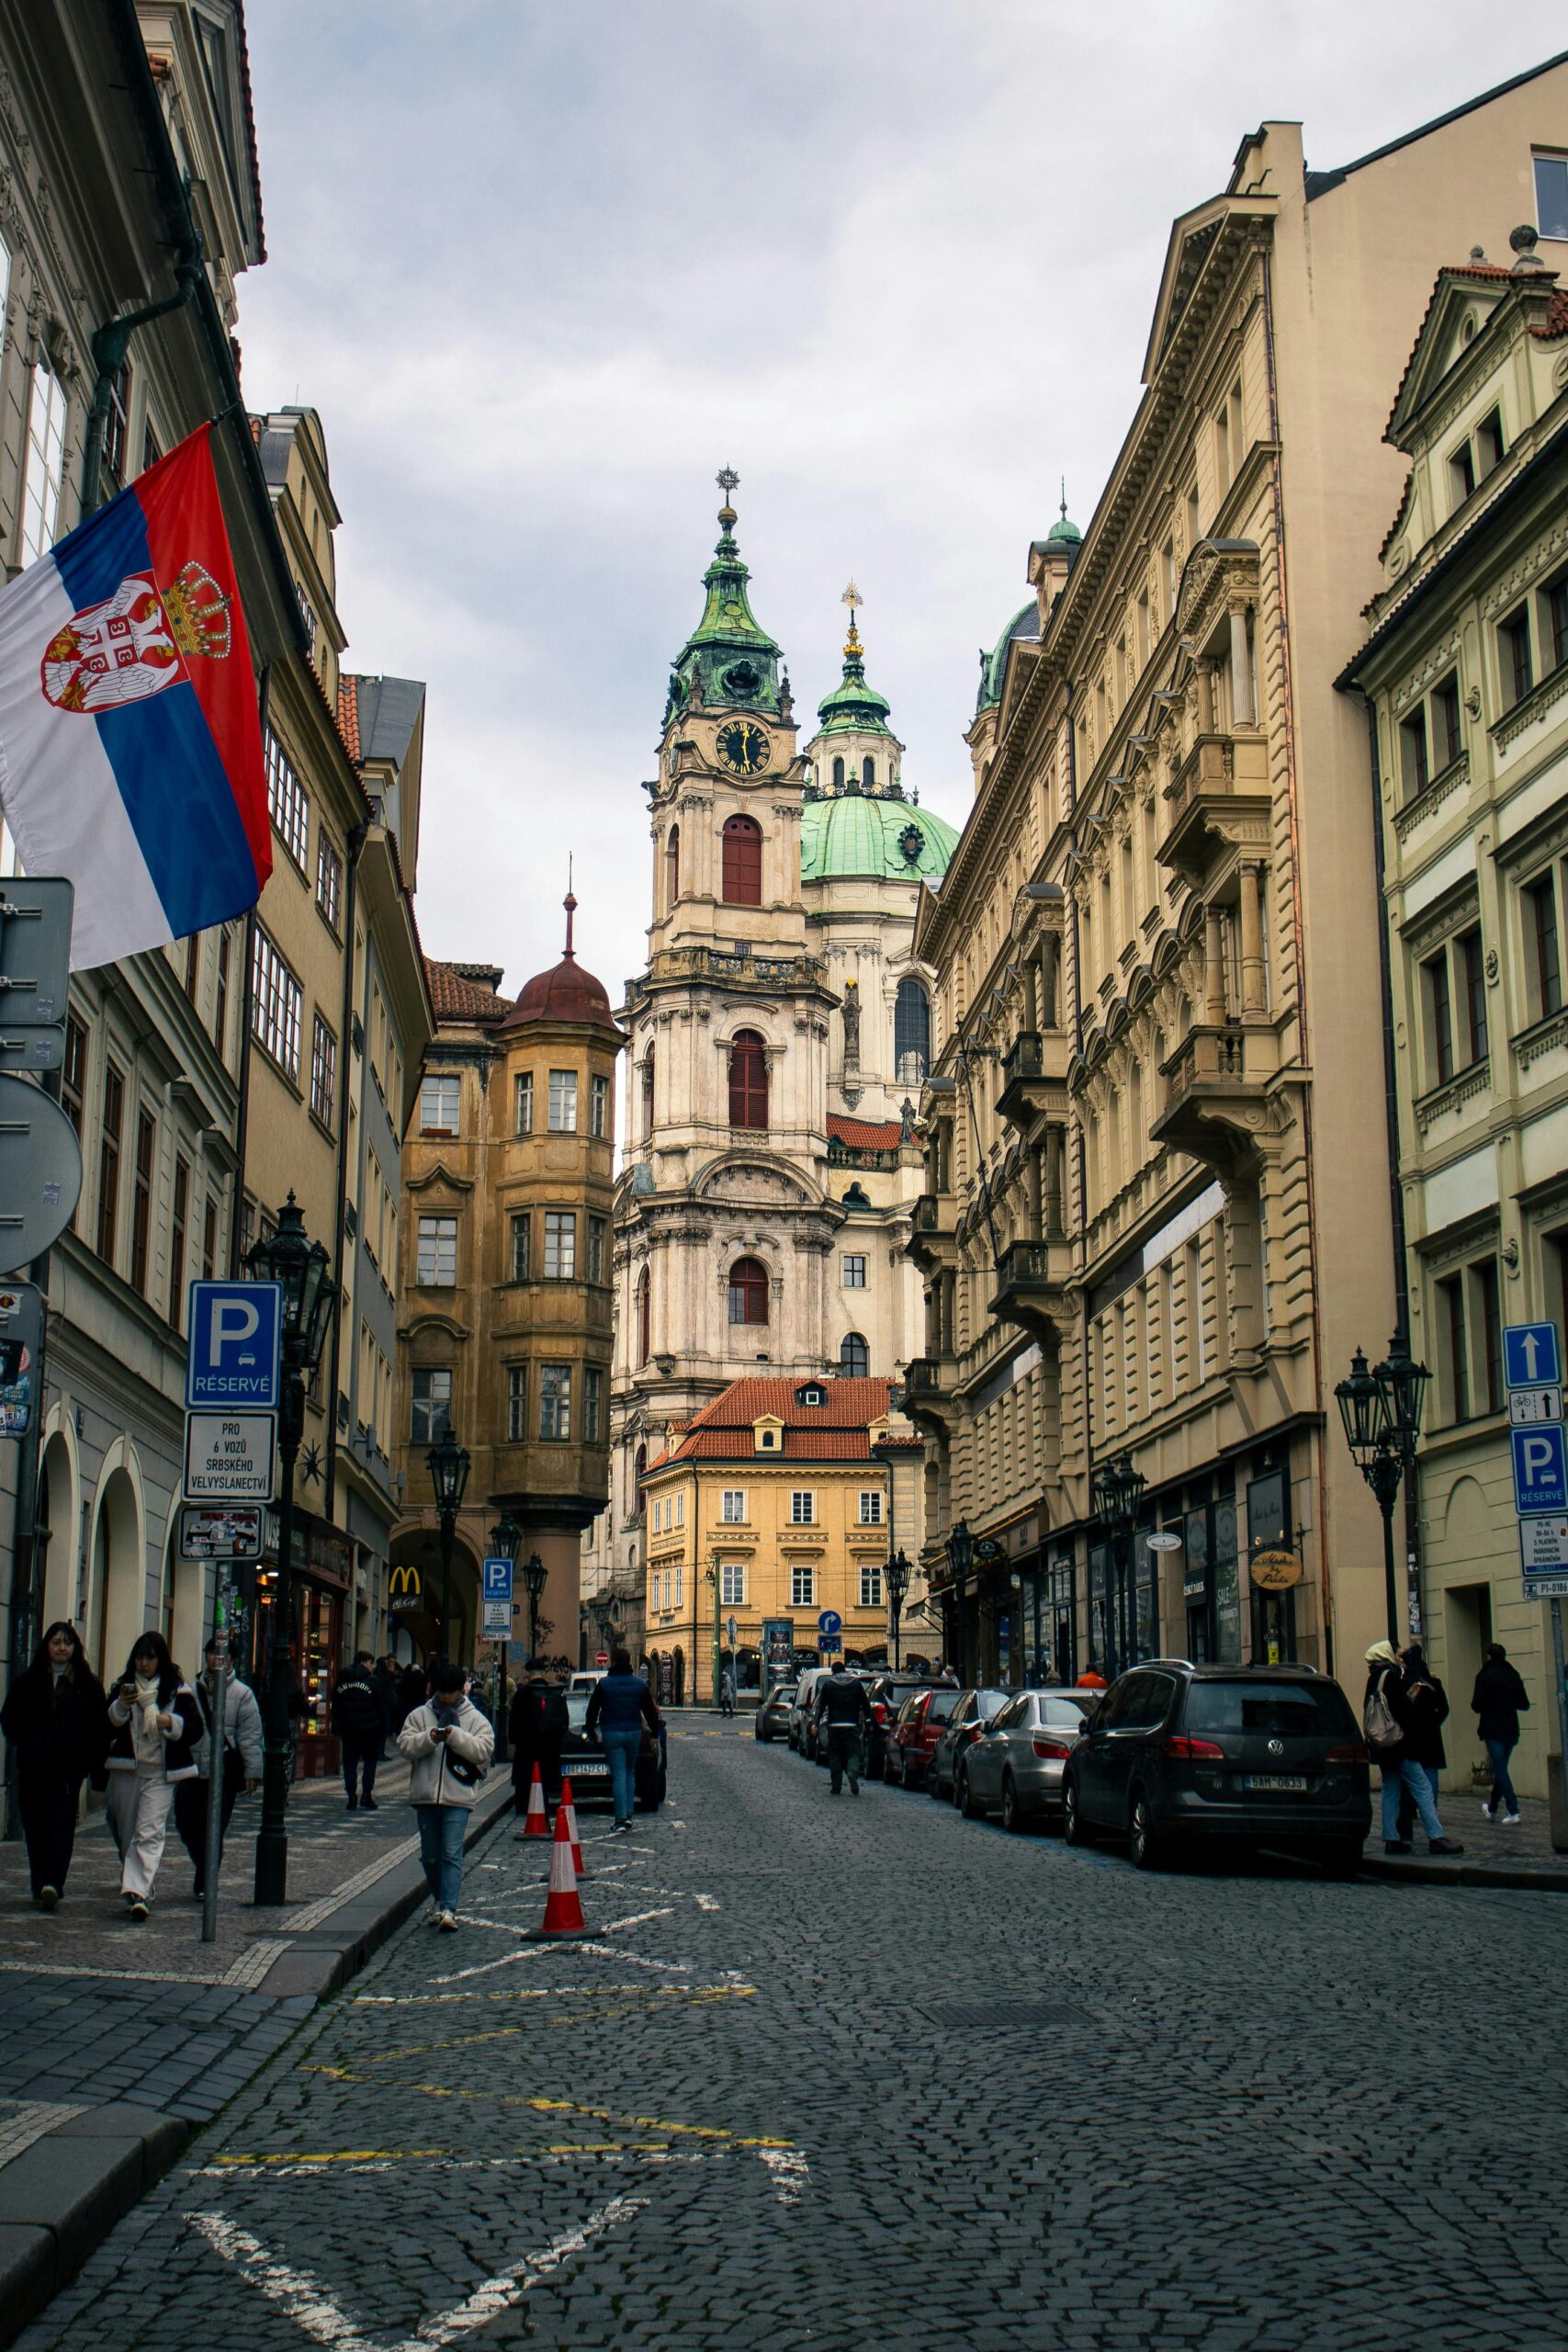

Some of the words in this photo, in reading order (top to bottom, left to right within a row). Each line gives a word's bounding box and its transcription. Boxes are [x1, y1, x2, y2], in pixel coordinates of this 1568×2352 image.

[209, 1298, 260, 1367] P
[195, 1374, 270, 1393] RÉSERVÉ
[221, 1423, 240, 1436] PRO
[213, 1442, 220, 1453] 6
[224, 1438, 247, 1453] VOZŮ
[206, 1456, 254, 1472] SRBSKÉHO
[1523, 1437, 1553, 1486] P
[191, 1474, 267, 1491] VELVYSLANECTVÍ
[1521, 1489, 1563, 1503] RÉSERVÉ
[490, 1565, 507, 1588] P
[1217, 1587, 1230, 1605] SALE
[1540, 1582, 1568, 1594] P1-0186
[1252, 1777, 1271, 1788] 5AM
[1278, 1777, 1303, 1789] 0633
